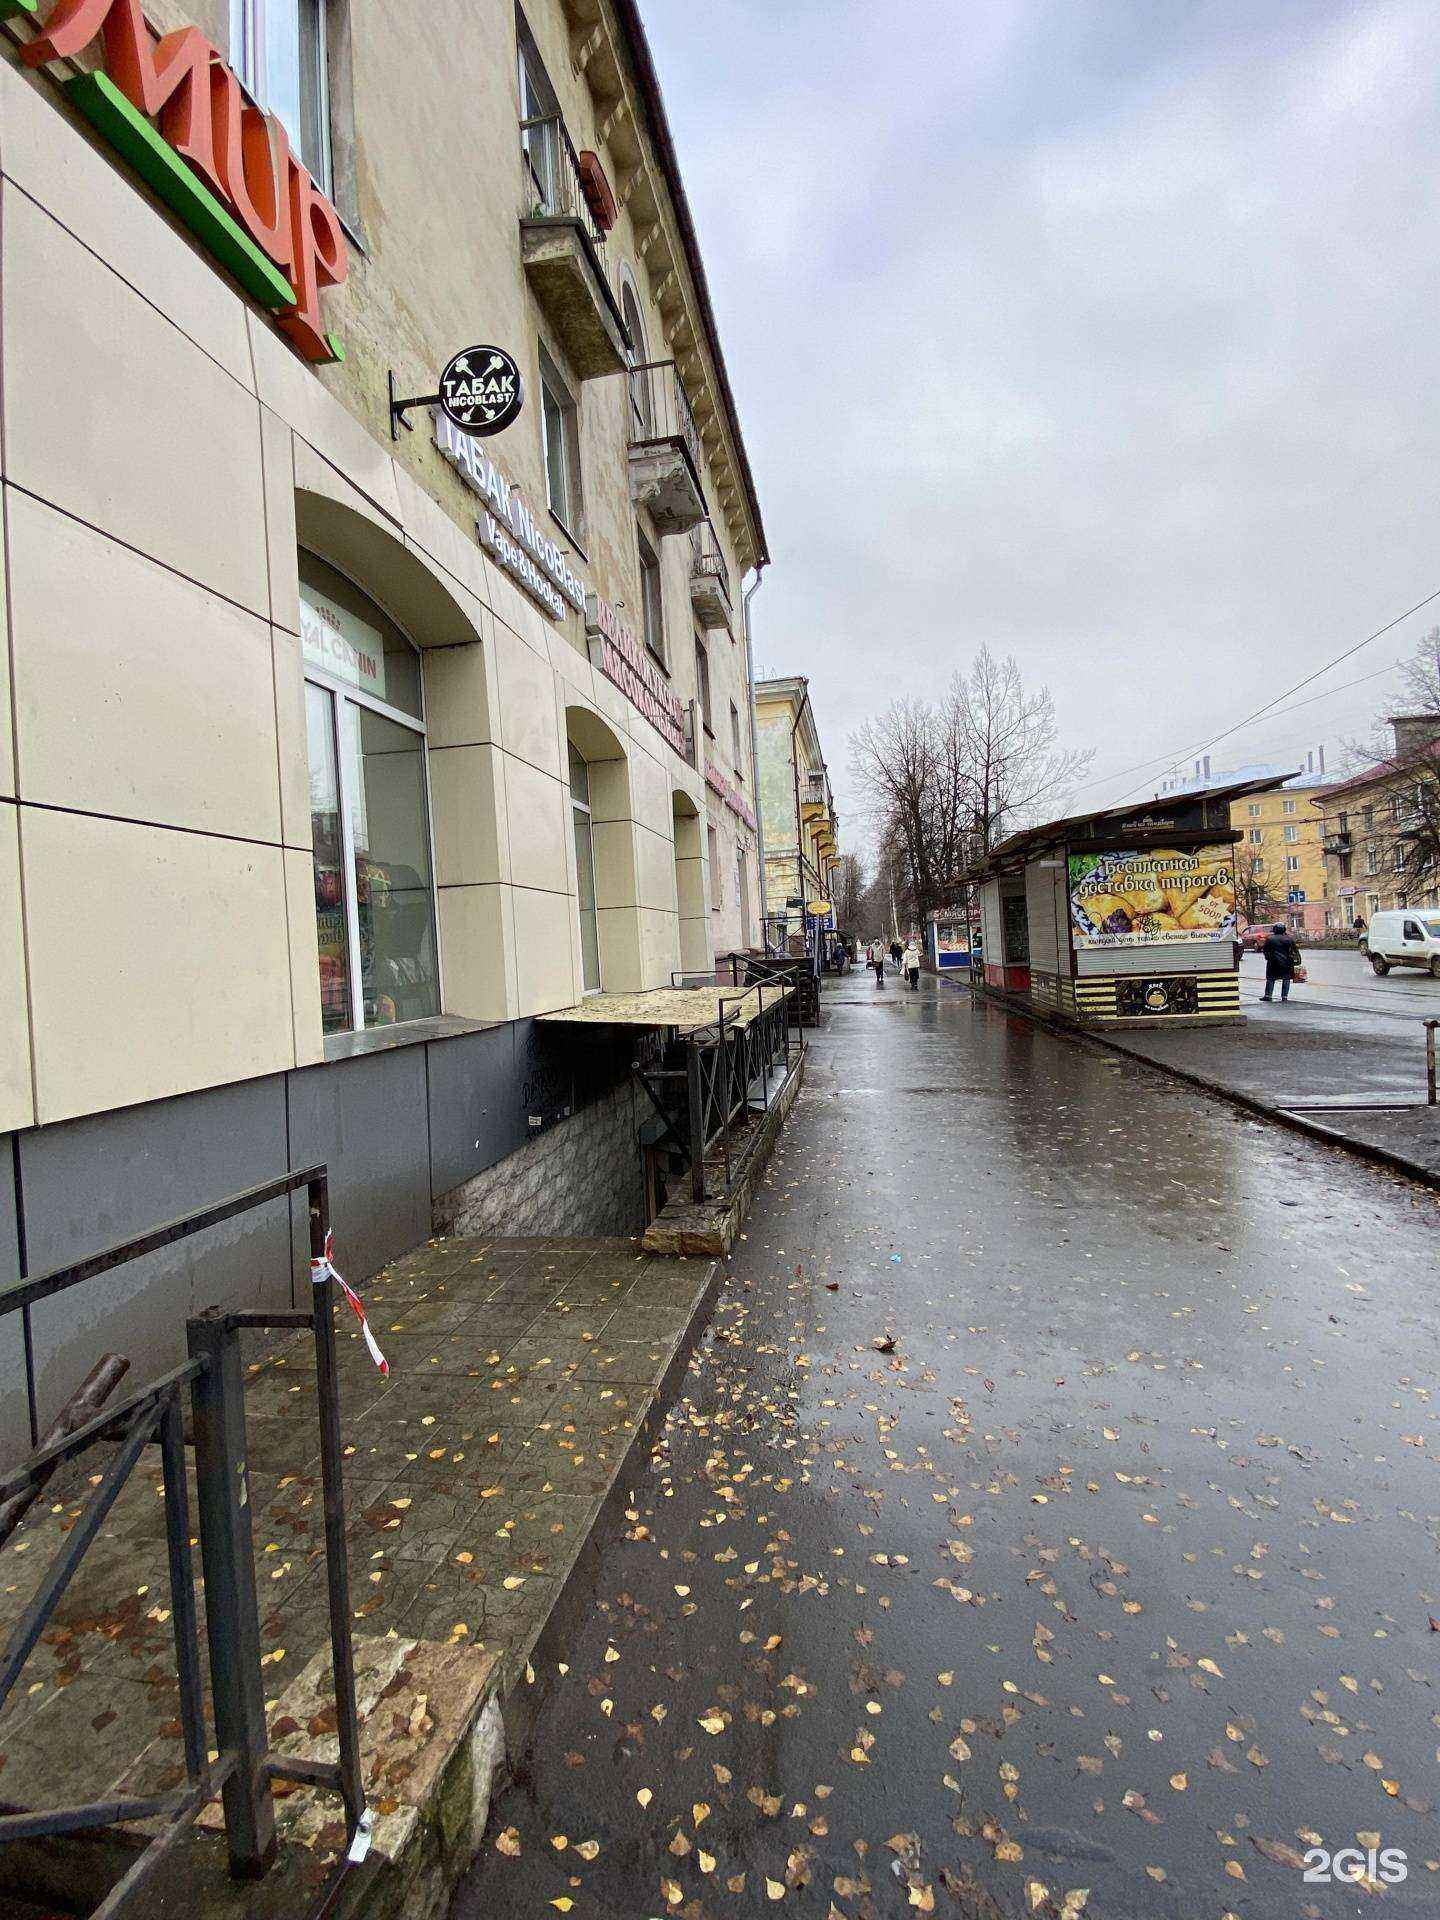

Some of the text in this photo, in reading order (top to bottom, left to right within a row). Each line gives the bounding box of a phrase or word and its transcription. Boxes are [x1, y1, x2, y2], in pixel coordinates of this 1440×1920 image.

[443, 375, 515, 397] ТАБАК
[448, 393, 512, 407] NICOBLAST
[1104, 858, 1199, 875] Бесплатная
[1079, 868, 1229, 900] доставка пирогов
